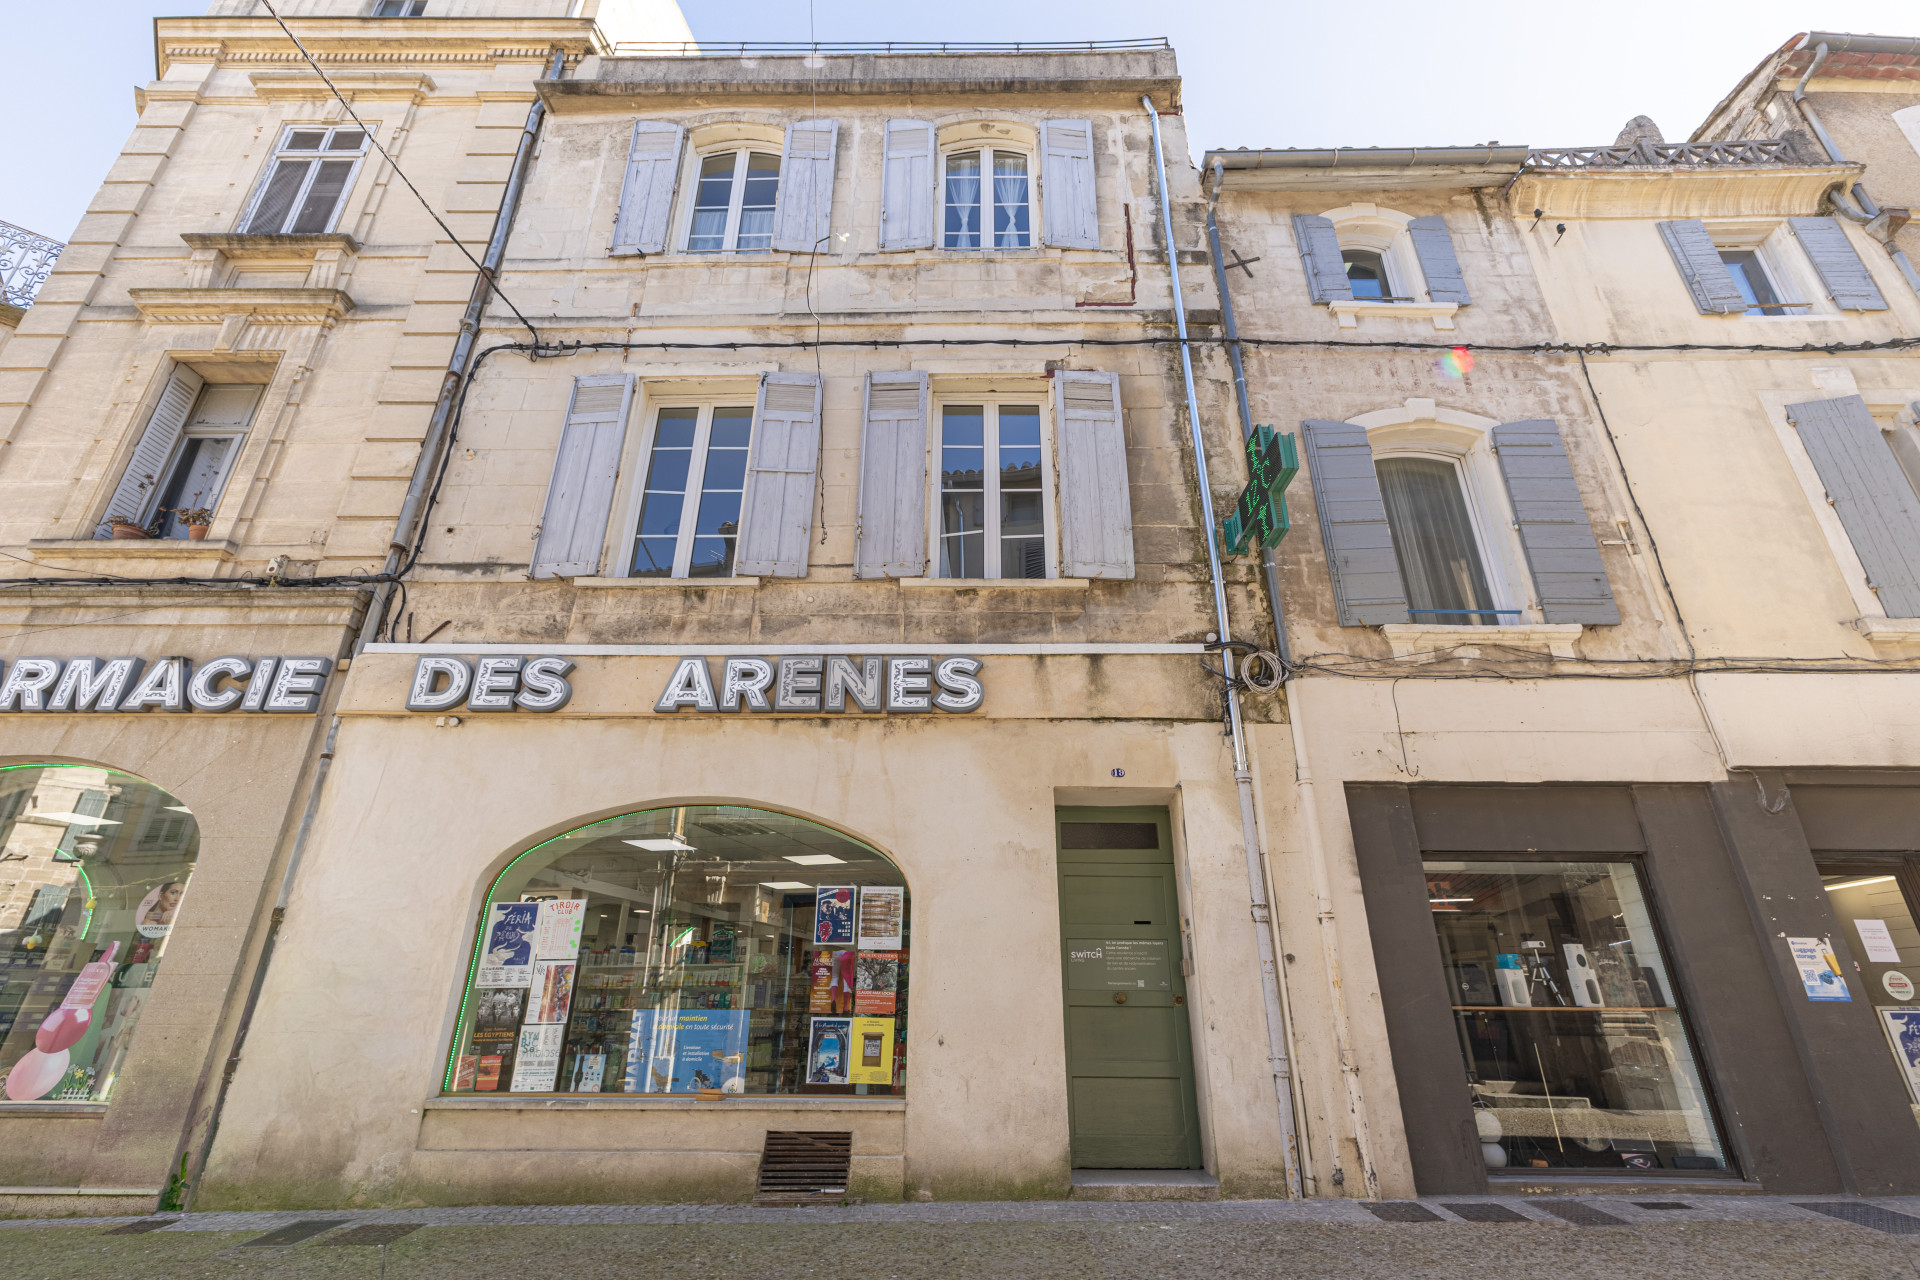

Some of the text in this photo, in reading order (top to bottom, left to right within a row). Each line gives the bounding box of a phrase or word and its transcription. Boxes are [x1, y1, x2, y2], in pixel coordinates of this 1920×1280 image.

[0, 655, 333, 713] RMACIE
[404, 654, 986, 713] DES ARENES
[679, 1014, 708, 1022] maintien
